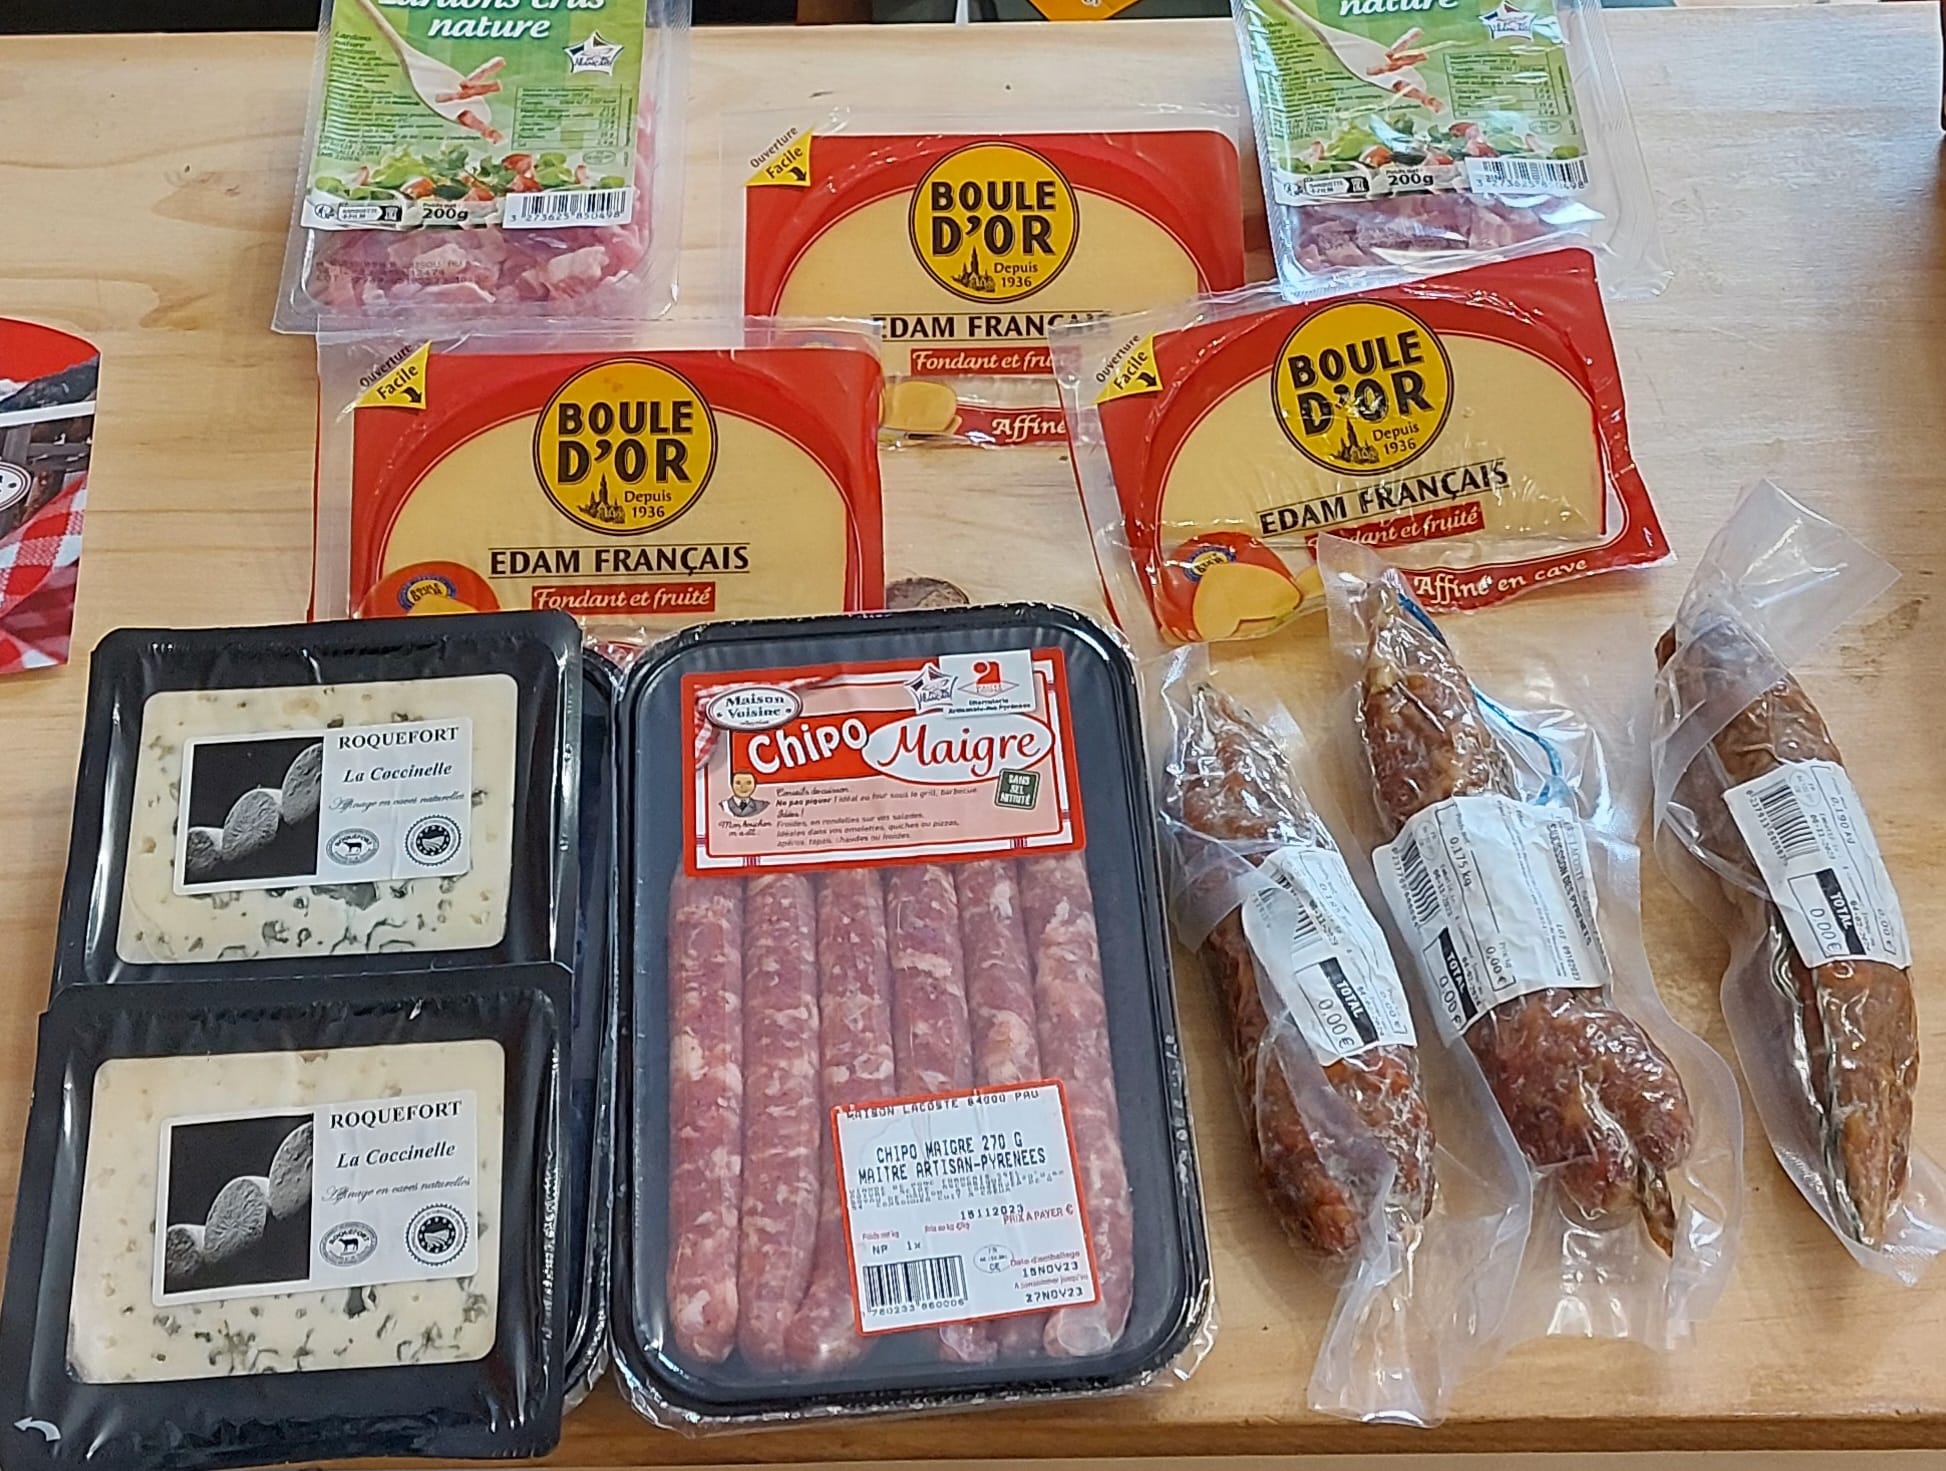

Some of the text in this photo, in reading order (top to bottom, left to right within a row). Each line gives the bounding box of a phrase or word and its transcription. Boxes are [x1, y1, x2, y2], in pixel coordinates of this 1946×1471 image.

[428, 16, 551, 38] nature
[749, 125, 800, 171] Ouverture
[765, 145, 805, 180] Facile
[1388, 172, 1434, 188] 200g
[930, 179, 1057, 213] BOULE
[422, 208, 469, 221] 200g
[993, 261, 1039, 276] Depuis
[1000, 275, 1033, 289] 1936
[358, 343, 414, 390] Ouverture
[913, 351, 998, 371] Fondant
[1001, 354, 1020, 369] et
[1094, 333, 1142, 384] Ouverture
[1113, 347, 1148, 391] Facile
[1288, 329, 1424, 391] BOULE
[376, 363, 419, 401] Facile
[558, 400, 694, 436] BOULE
[1371, 421, 1420, 444] Depuis
[1383, 437, 1417, 457] 1936
[624, 489, 672, 505] Depuis
[1259, 458, 1511, 536] EDAM FRANÇAIS
[631, 505, 665, 519] 1936
[1400, 520, 1421, 538] et
[1422, 506, 1480, 536] fruité
[490, 545, 750, 577] EDAM FRANÇAIS
[1497, 578, 1527, 592] en
[1534, 559, 1588, 582] cave
[534, 585, 711, 611] Fondant et fruité
[726, 693, 785, 708] Maison
[727, 706, 781, 719] Voisine
[339, 727, 460, 750] ROQUEFORT
[877, 724, 1040, 777] Maigre
[343, 762, 452, 783] La Coccinelle
[776, 799, 787, 807] Ne
[788, 798, 804, 808] pas
[805, 797, 832, 808] piquer
[1830, 892, 1853, 930] TOTAL
[1446, 953, 1467, 994] TOTAL
[1336, 979, 1361, 1018] TOTAL
[1015, 1089, 1040, 1101] PAU
[329, 1100, 463, 1130] ROQUEFORT
[336, 1141, 456, 1170] La Coccinelle
[876, 1131, 1023, 1164] CHIPO MAIGRE 270 G
[858, 1147, 1047, 1185] MAITRE ARTISAN-PYRENEES
[1003, 1213, 1025, 1225] PRIX
[1025, 1211, 1033, 1221] A
[1033, 1208, 1064, 1221] PAYER
[872, 1245, 888, 1255] NP
[1010, 1258, 1030, 1267] Date
[1026, 1287, 1083, 1303] 27NOV23
